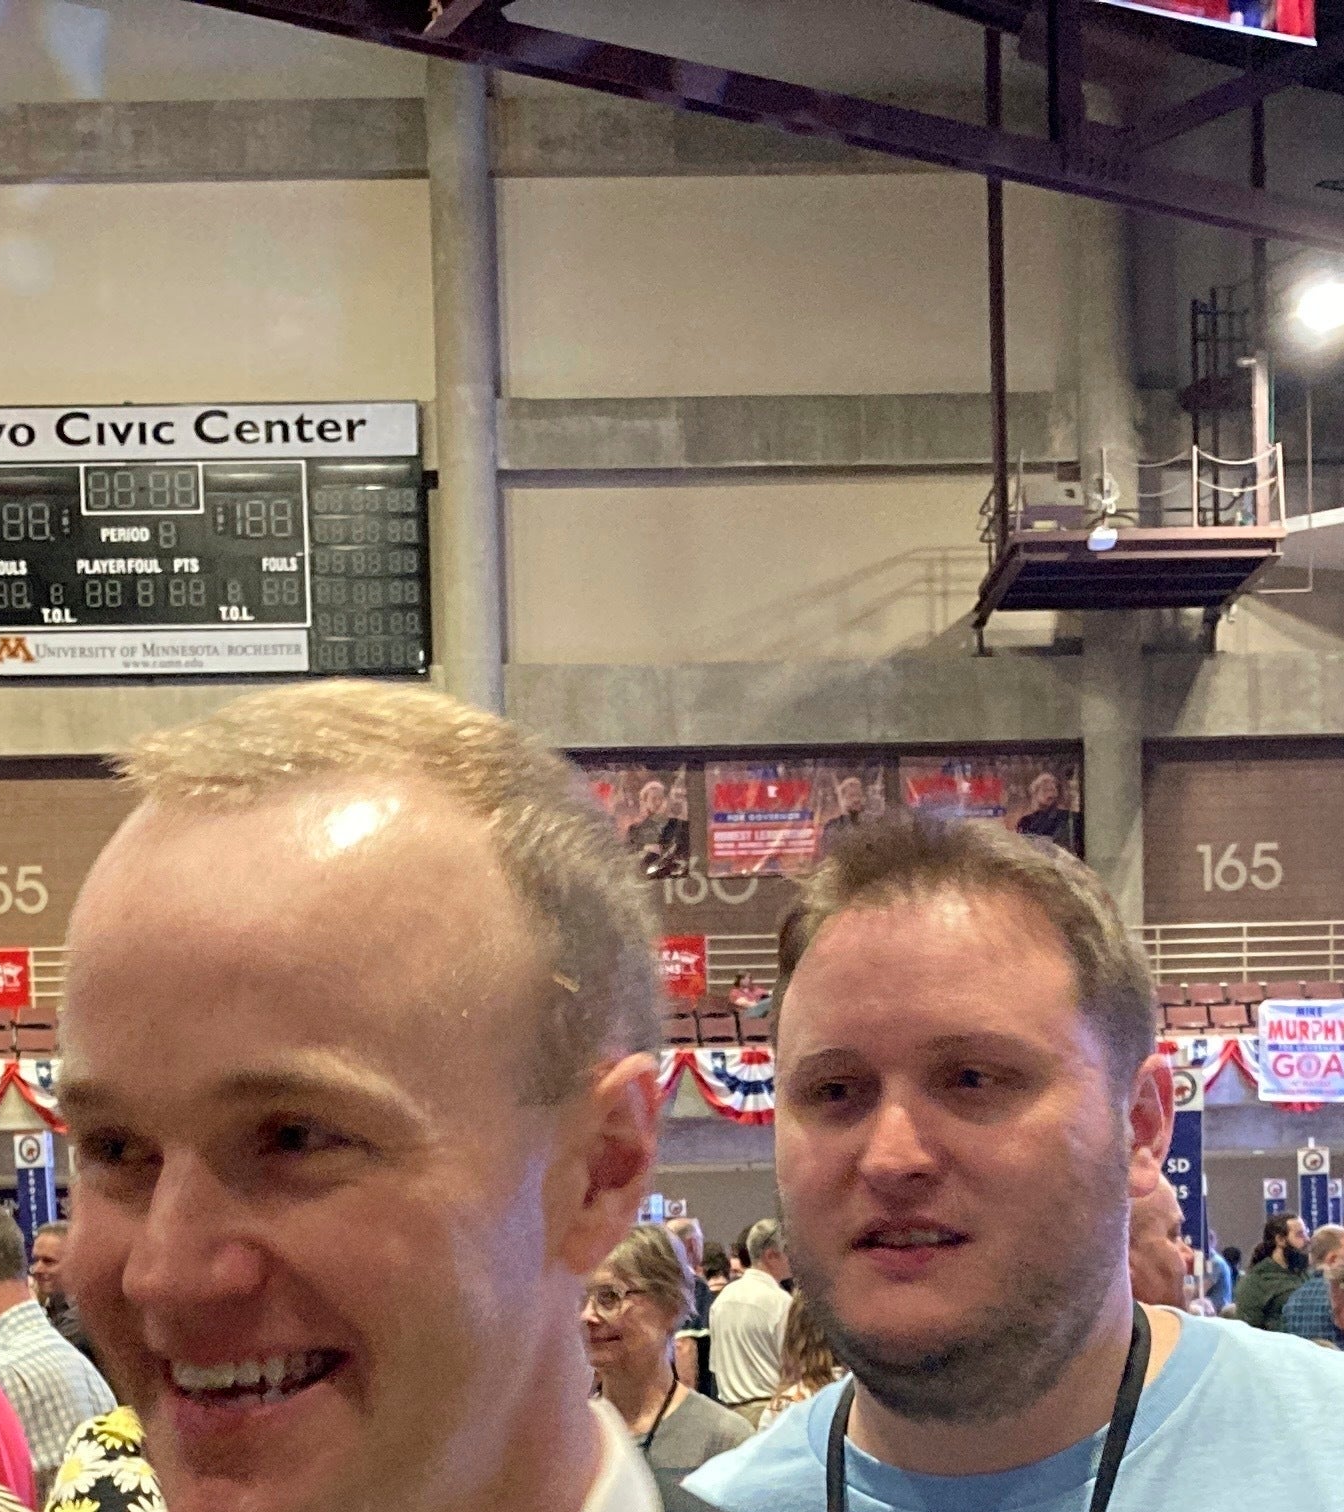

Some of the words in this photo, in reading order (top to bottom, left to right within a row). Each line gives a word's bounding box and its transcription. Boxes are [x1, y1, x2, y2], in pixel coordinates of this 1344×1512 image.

[193, 409, 367, 444] Center
[100, 527, 151, 543] PERIOD
[76, 558, 126, 575] PLAYER
[128, 558, 163, 574] FOUL
[173, 557, 200, 573] PTS
[261, 556, 299, 573] FOULS
[1196, 841, 1284, 892] 165
[1167, 1158, 1191, 1174] SD
